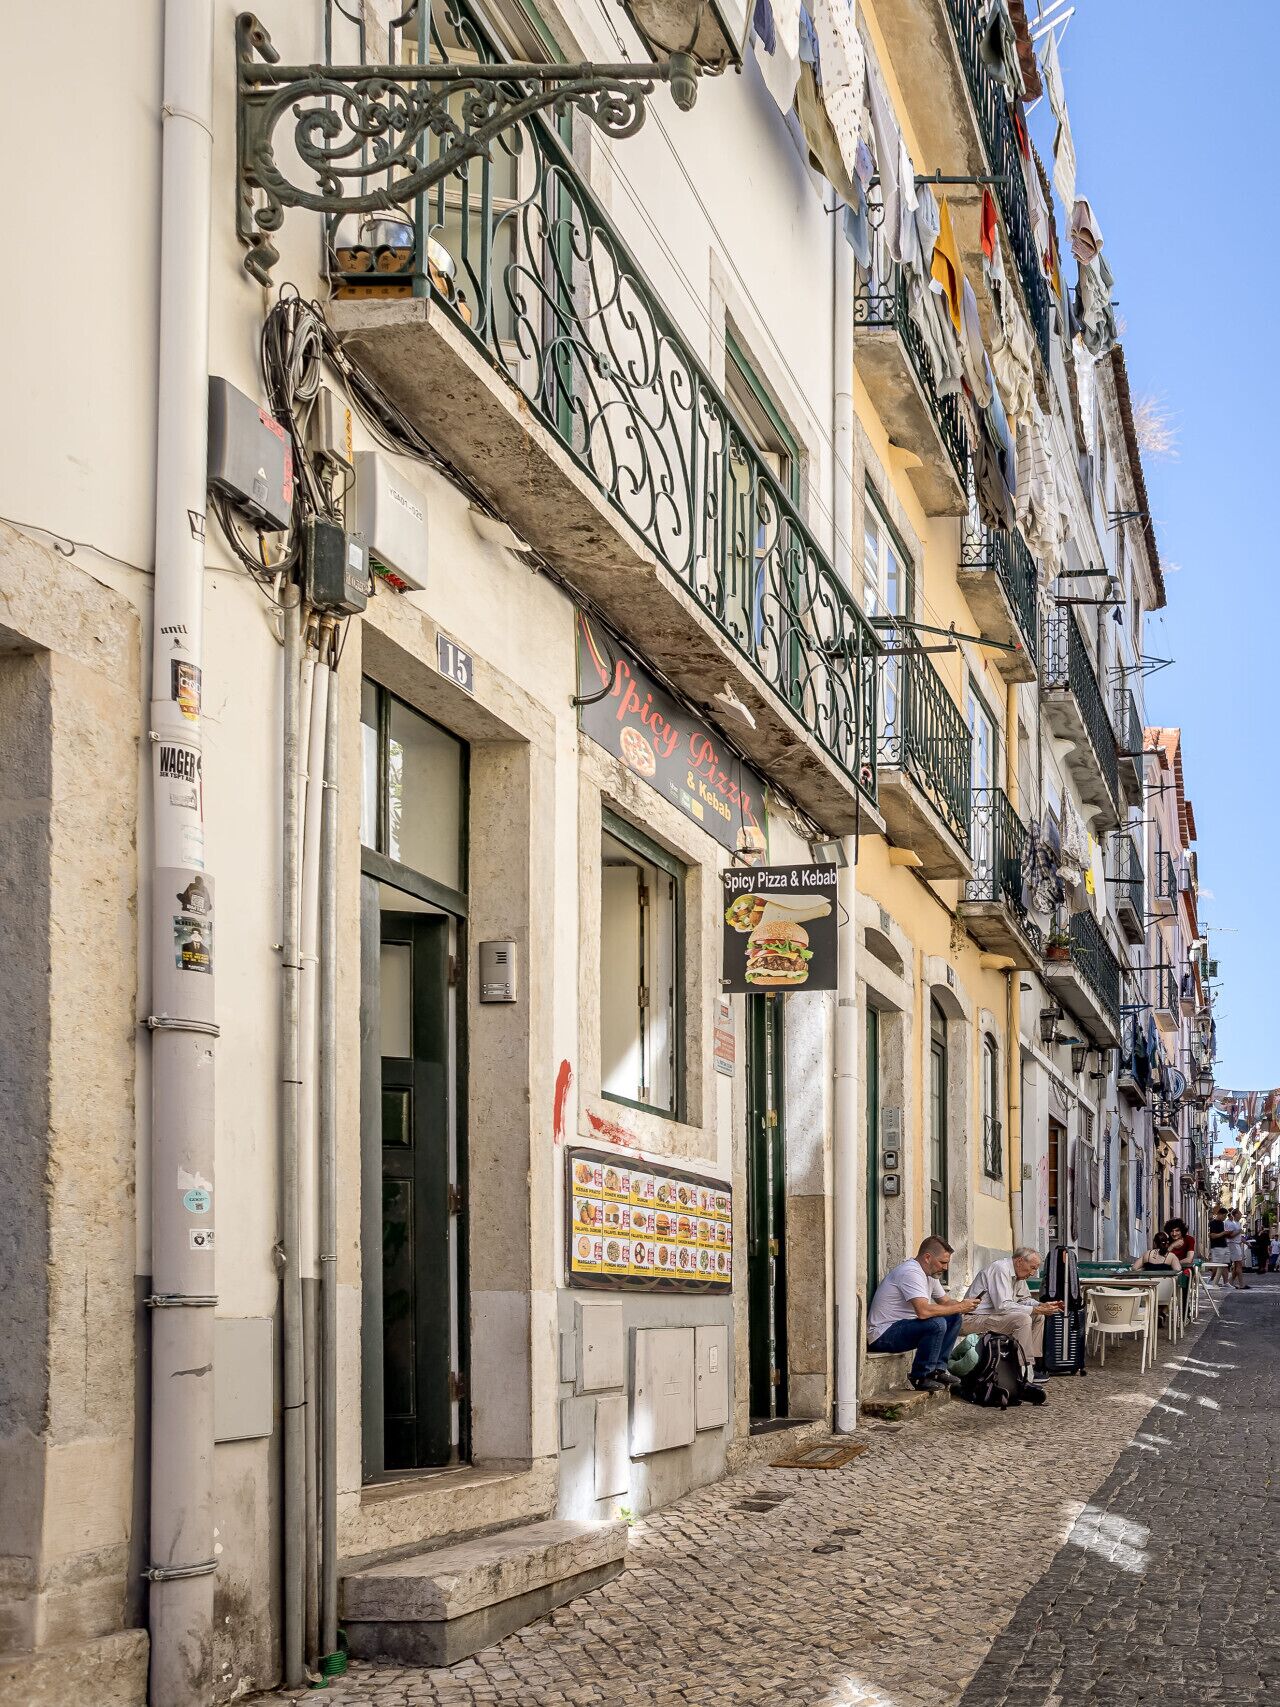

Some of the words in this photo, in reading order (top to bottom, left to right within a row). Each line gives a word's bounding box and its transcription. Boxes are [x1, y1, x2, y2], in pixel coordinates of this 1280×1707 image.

[447, 643, 468, 684] 15
[609, 659, 680, 758] Spicy
[687, 732, 752, 813] Pizza
[160, 746, 195, 779] WAGER
[686, 771, 696, 791] &
[699, 782, 732, 823] Kebab
[725, 872, 755, 892] Spicy
[758, 871, 787, 888] Pizza
[791, 870, 799, 887] &
[802, 869, 837, 886] Kebab
